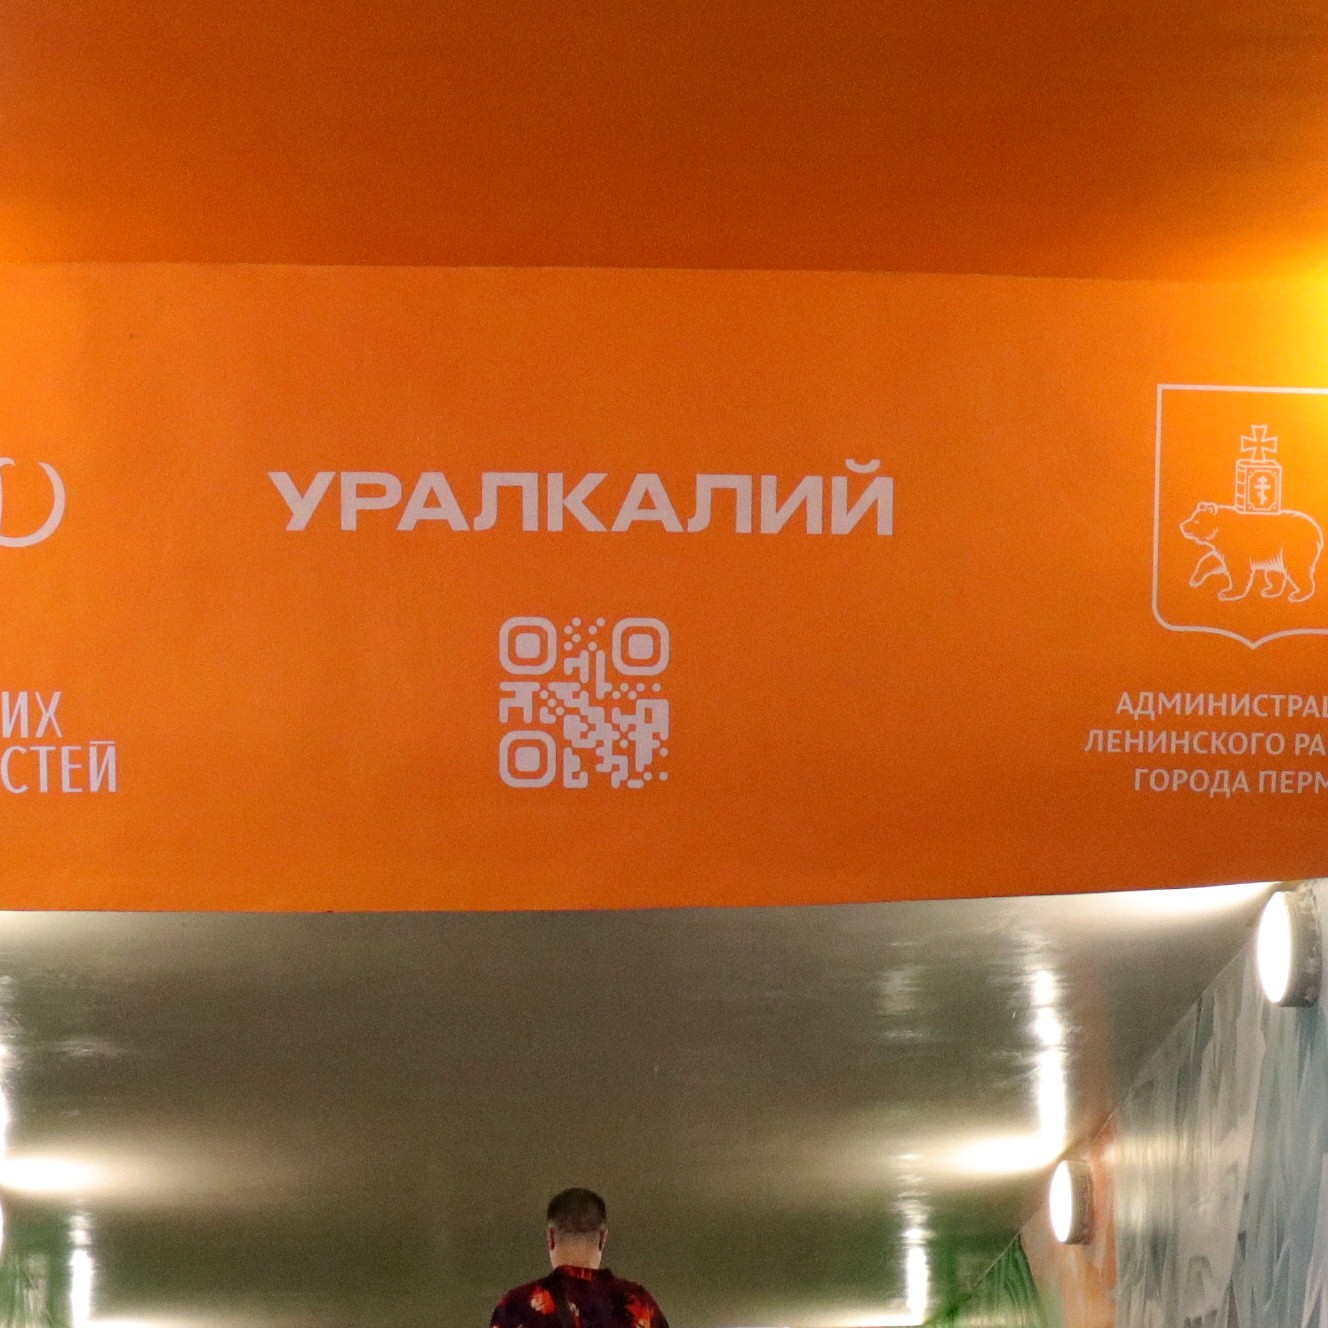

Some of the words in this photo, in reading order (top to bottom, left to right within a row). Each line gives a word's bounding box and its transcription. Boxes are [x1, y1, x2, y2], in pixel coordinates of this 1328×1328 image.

[267, 458, 894, 537] УРАЛКАЛИЙ
[1083, 728, 1286, 757] ЛЕНИНСКОГО
[1133, 767, 1251, 798] ГОРОДА
